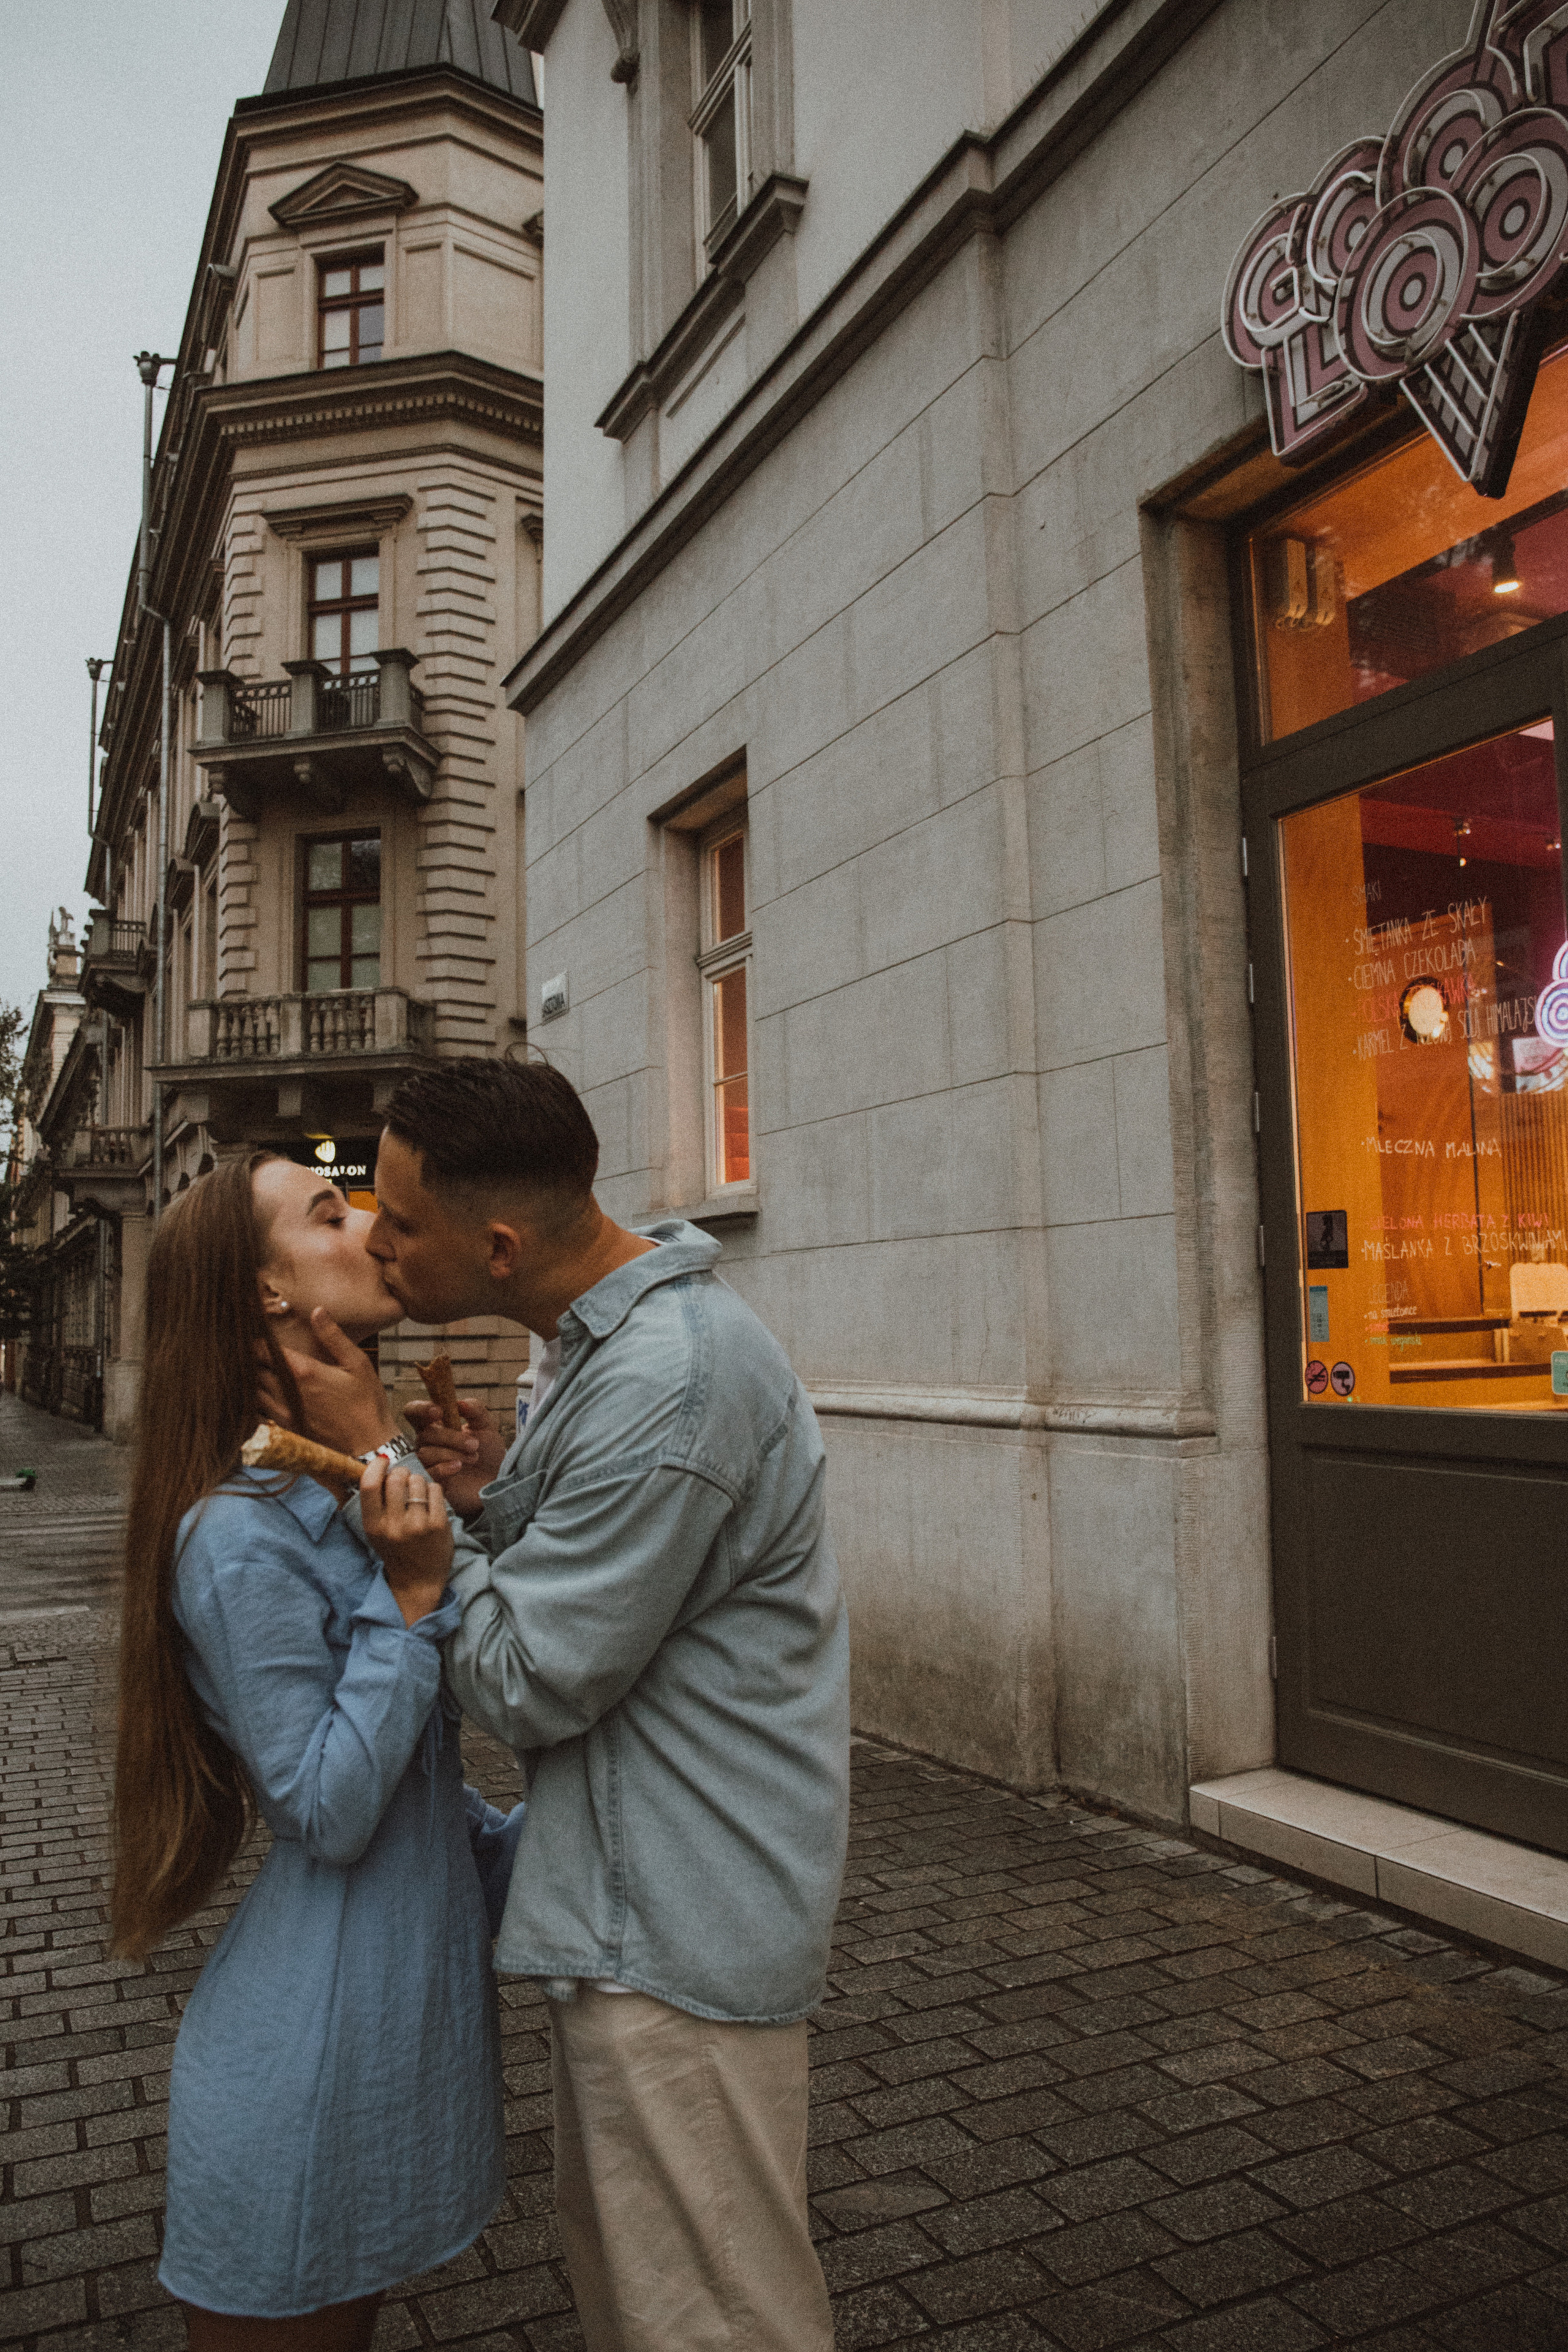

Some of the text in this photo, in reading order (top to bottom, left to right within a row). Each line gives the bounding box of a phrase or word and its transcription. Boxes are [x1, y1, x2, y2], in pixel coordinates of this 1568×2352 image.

[1421, 910, 1438, 941] ZE
[1447, 896, 1487, 933] SKAŁY
[1354, 938, 1477, 990] CIEMNA CZEKOLADA
[1357, 1029, 1394, 1060] KARMEL
[1399, 1023, 1409, 1050] Z
[1486, 995, 1537, 1036] HIMALAJS
[1365, 1136, 1502, 1159] MLECZNA MALINA
[1433, 1212, 1496, 1231] HERBATA
[1518, 1212, 1548, 1228] KIWI
[1364, 1237, 1434, 1261] MAŚLANKA
[1444, 1236, 1453, 1256] Z
